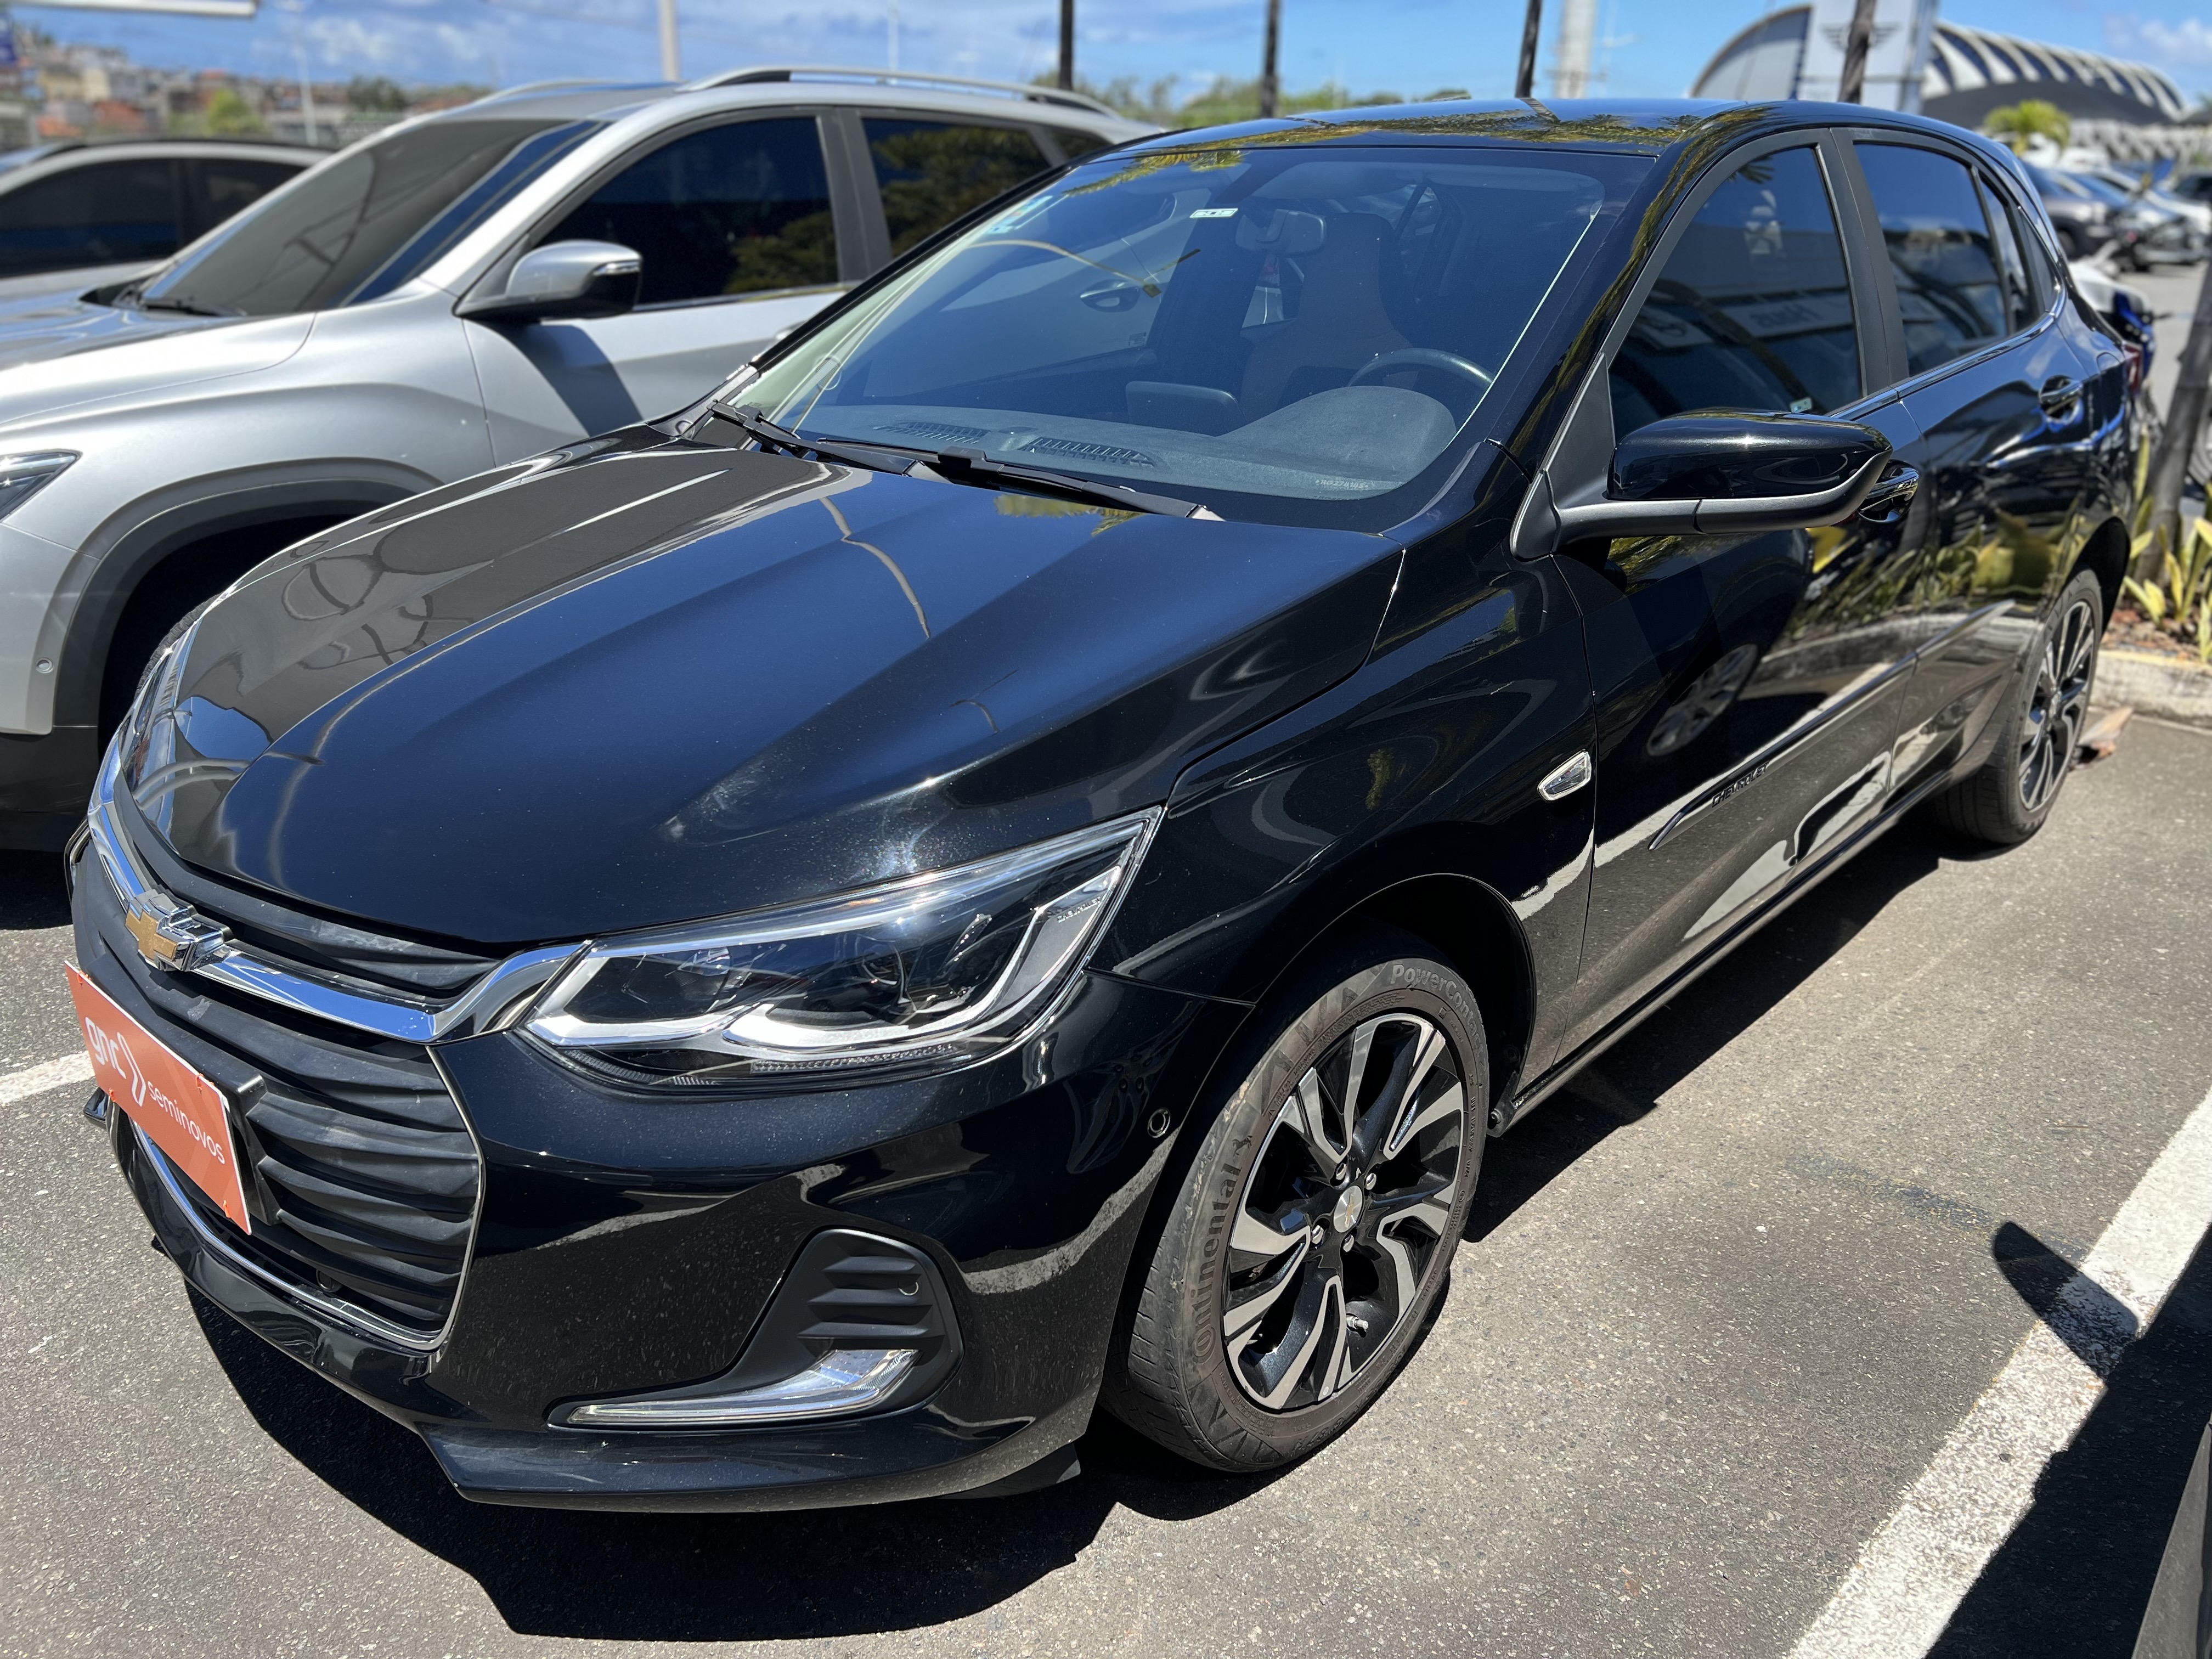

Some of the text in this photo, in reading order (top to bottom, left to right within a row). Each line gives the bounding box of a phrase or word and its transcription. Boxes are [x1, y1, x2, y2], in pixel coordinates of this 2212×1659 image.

[1711, 760, 1770, 808] CHEVROLET
[1391, 964, 1483, 1054] PowerContact
[85, 1017, 225, 1165] gnc seminovos
[1190, 1163, 1242, 1365] Continental
